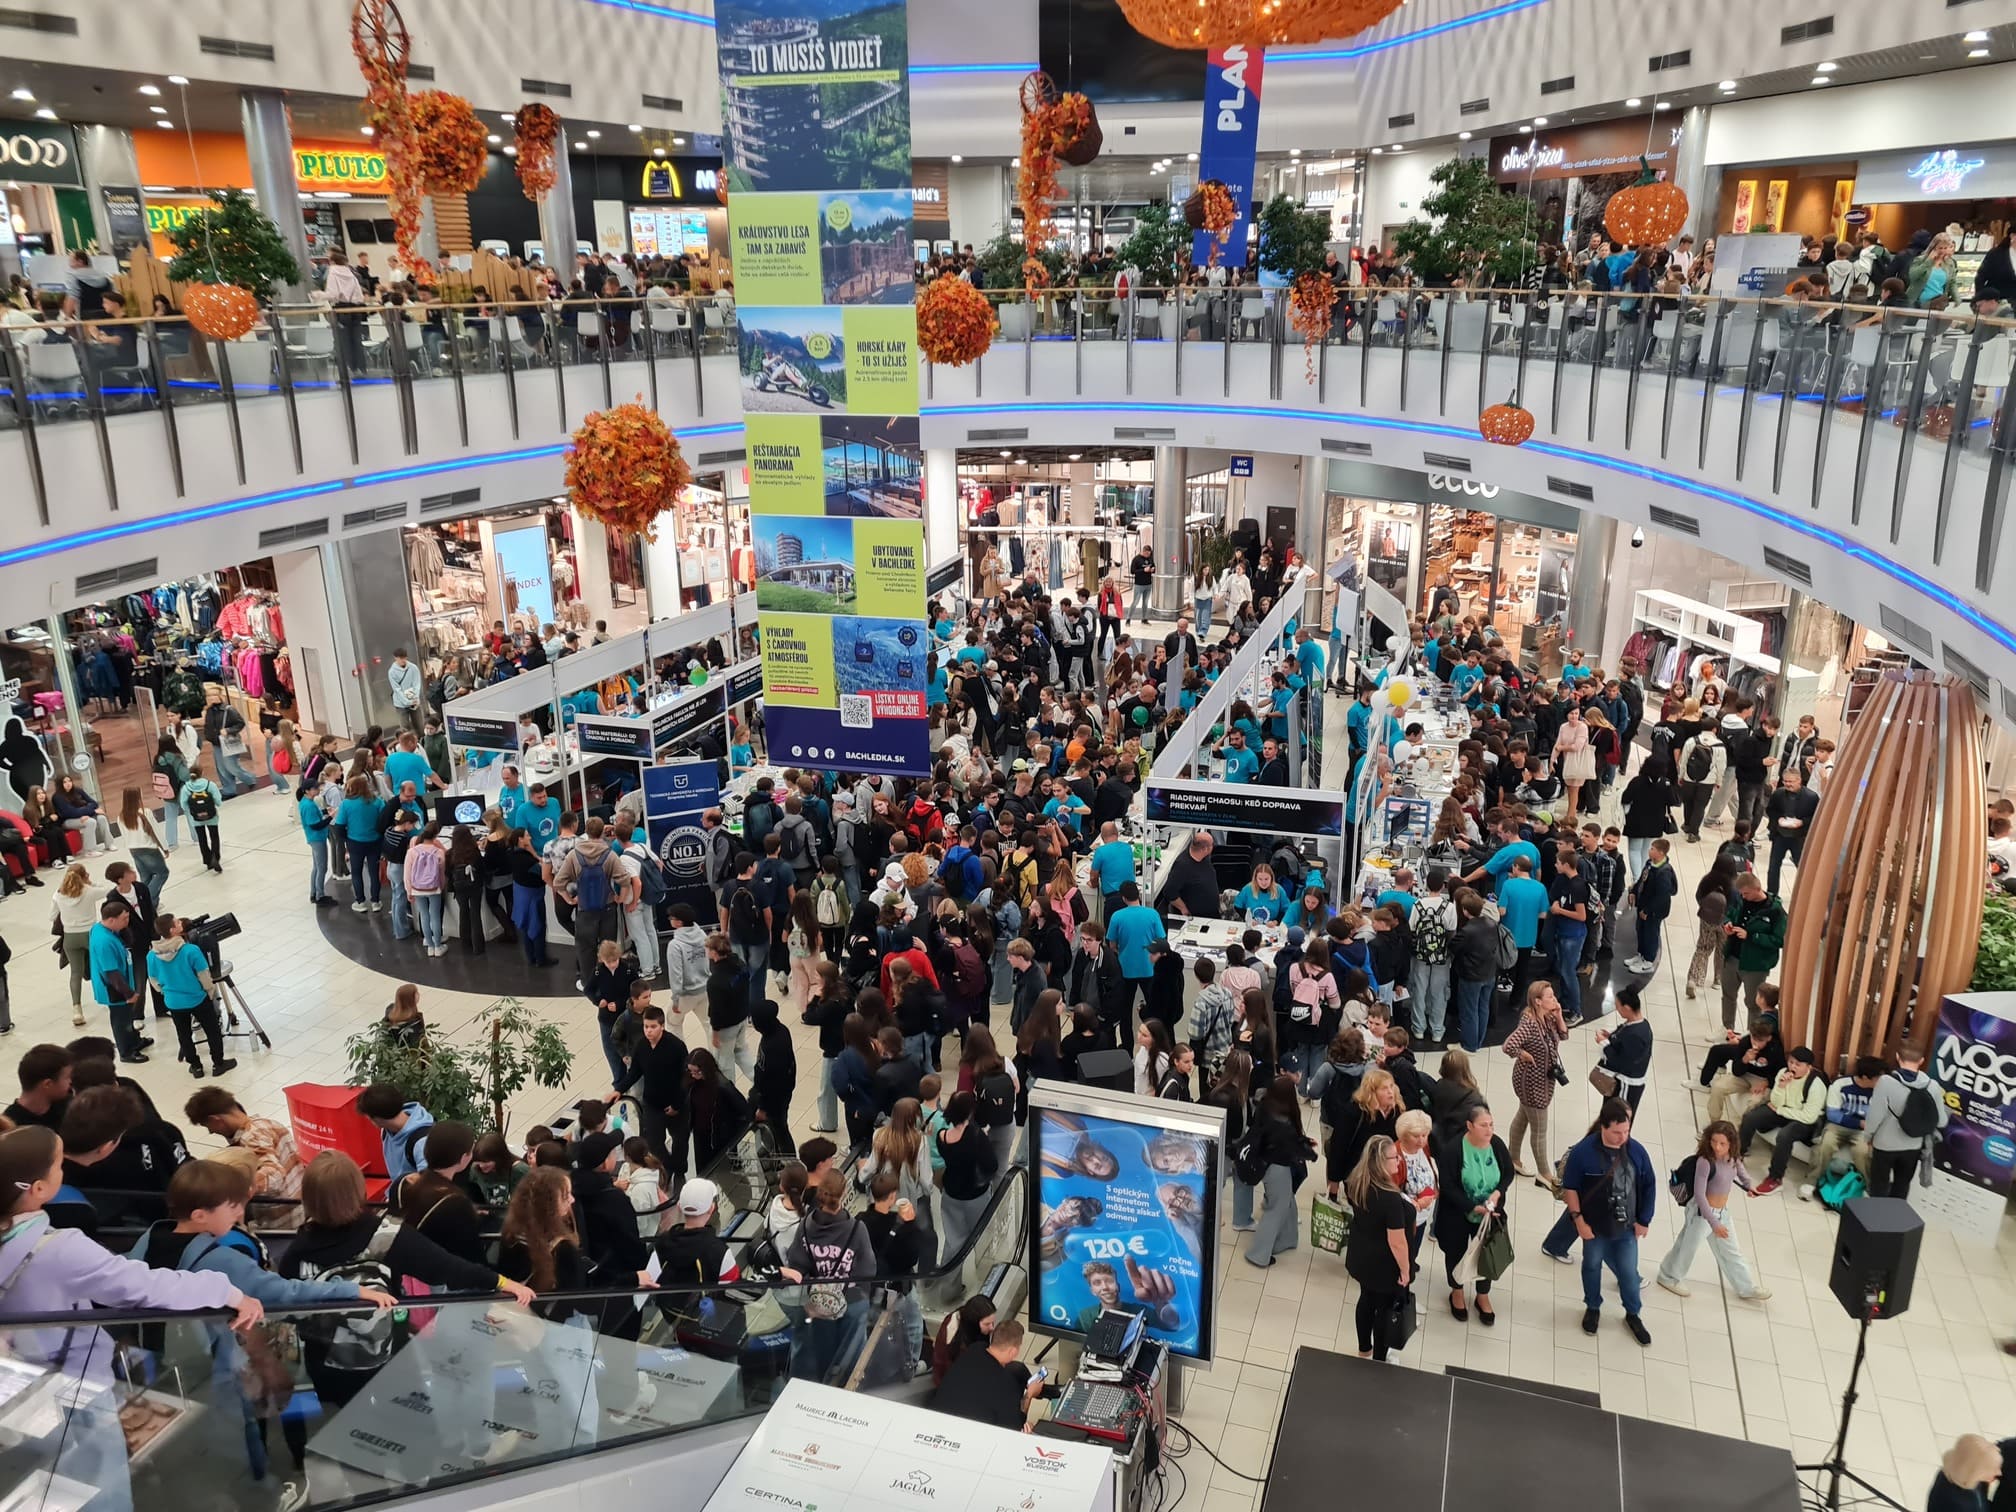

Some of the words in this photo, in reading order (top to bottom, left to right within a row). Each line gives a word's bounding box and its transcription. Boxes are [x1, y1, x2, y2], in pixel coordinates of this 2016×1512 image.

[749, 43, 768, 73] TO
[772, 37, 825, 72] MUSÍŠ
[829, 34, 883, 70] VIDIEŤ
[300, 154, 385, 179] PLUTO
[791, 225, 810, 239] LESA
[746, 243, 762, 255] TAM
[763, 243, 774, 255] SA
[776, 241, 807, 255] ZABAVÍŠ
[856, 339, 885, 353] HORSKÉ
[887, 339, 906, 353] KÁRY
[861, 355, 871, 367] TO
[873, 355, 880, 367] SI
[882, 354, 907, 368] UŽIJEŠ
[752, 443, 801, 458] REŠTAURÁCIA
[754, 458, 794, 472] PANORAMA
[1236, 459, 1248, 467] WC
[872, 545, 914, 557] UBYTOVANIE
[871, 557, 877, 568] V
[878, 558, 916, 570] BACHLEDKE
[517, 576, 542, 589] NDEX
[766, 640, 771, 650] S
[772, 639, 806, 651] ČAROVNOU
[767, 652, 809, 664] ATMOSFÉROU
[874, 693, 896, 705] LÍSTKY
[897, 693, 919, 705] ONLINE
[875, 704, 920, 717] VÝHODNEJŠIE!
[845, 751, 906, 764] BACHLEDKA.SK
[1169, 793, 1206, 803] RIADENIE
[1207, 797, 1244, 807] CHAOSU:
[1244, 799, 1261, 808] KEĎ
[1261, 801, 1302, 811] DOPRAVA
[1169, 802, 1208, 812] PREKVAPÍ
[673, 844, 703, 860] NO.1
[1291, 1005, 1310, 1017] NIKE
[1105, 1185, 1112, 1193] S
[1112, 1186, 1150, 1200] optickým
[1105, 1194, 1150, 1207] internetom
[1105, 1202, 1136, 1214] môžete
[1136, 1207, 1161, 1218] získať
[1105, 1211, 1138, 1223] odmenu
[1083, 1237, 1126, 1260] 120
[1127, 1234, 1149, 1256] €
[1168, 1256, 1193, 1266] ročne
[795, 1402, 826, 1417] MAURICE
[838, 1413, 870, 1428] LACROIX
[914, 1432, 961, 1450] FORTIS
[1023, 1455, 1068, 1470] VOSTOK
[1026, 1462, 1060, 1473] EUROPE
[888, 1478, 937, 1500] JAGUAR
[744, 1486, 803, 1509] CERTINA
